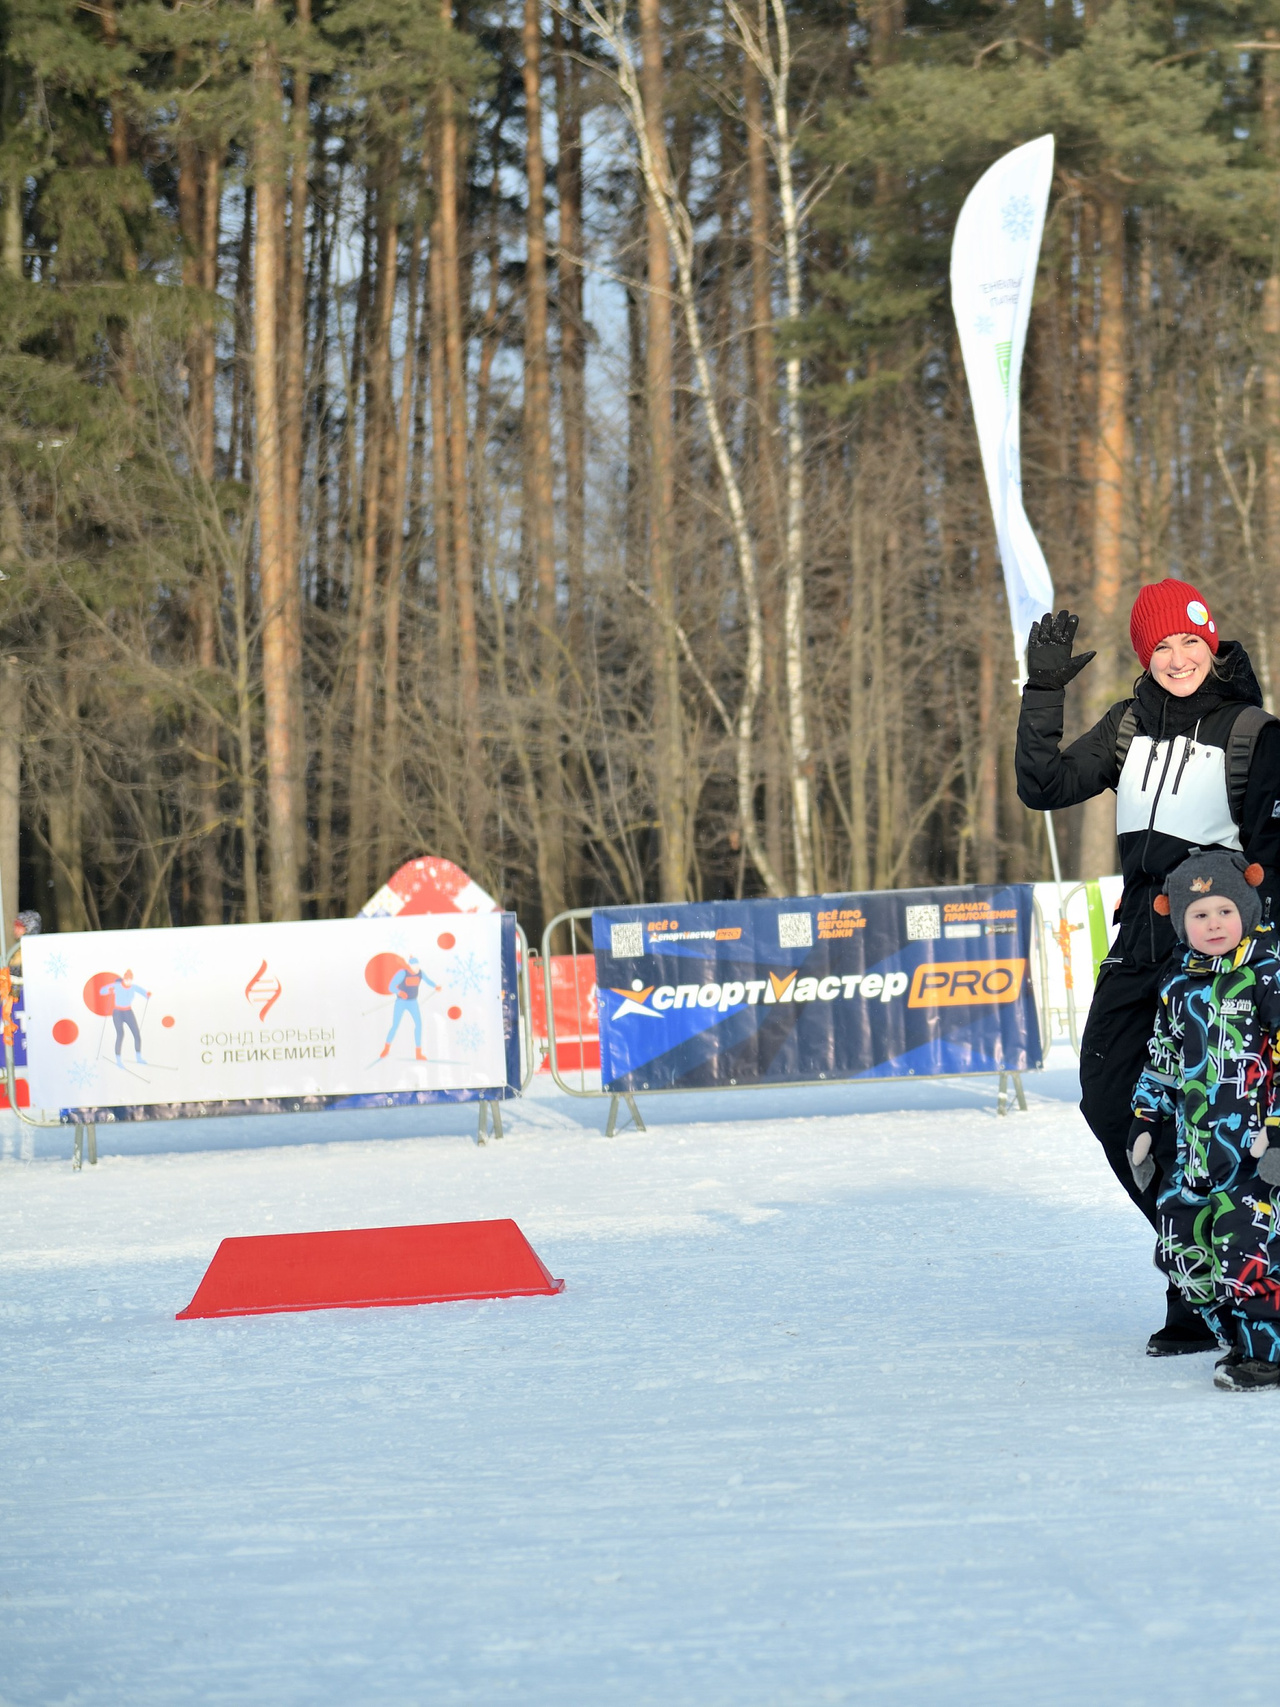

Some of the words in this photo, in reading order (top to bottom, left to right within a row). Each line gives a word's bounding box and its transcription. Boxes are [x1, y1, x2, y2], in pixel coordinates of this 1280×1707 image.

[918, 968, 1013, 998] PRO
[200, 1031, 254, 1046] ФОНД
[259, 1027, 335, 1043] БОРЬБЫ
[201, 1051, 213, 1064] С
